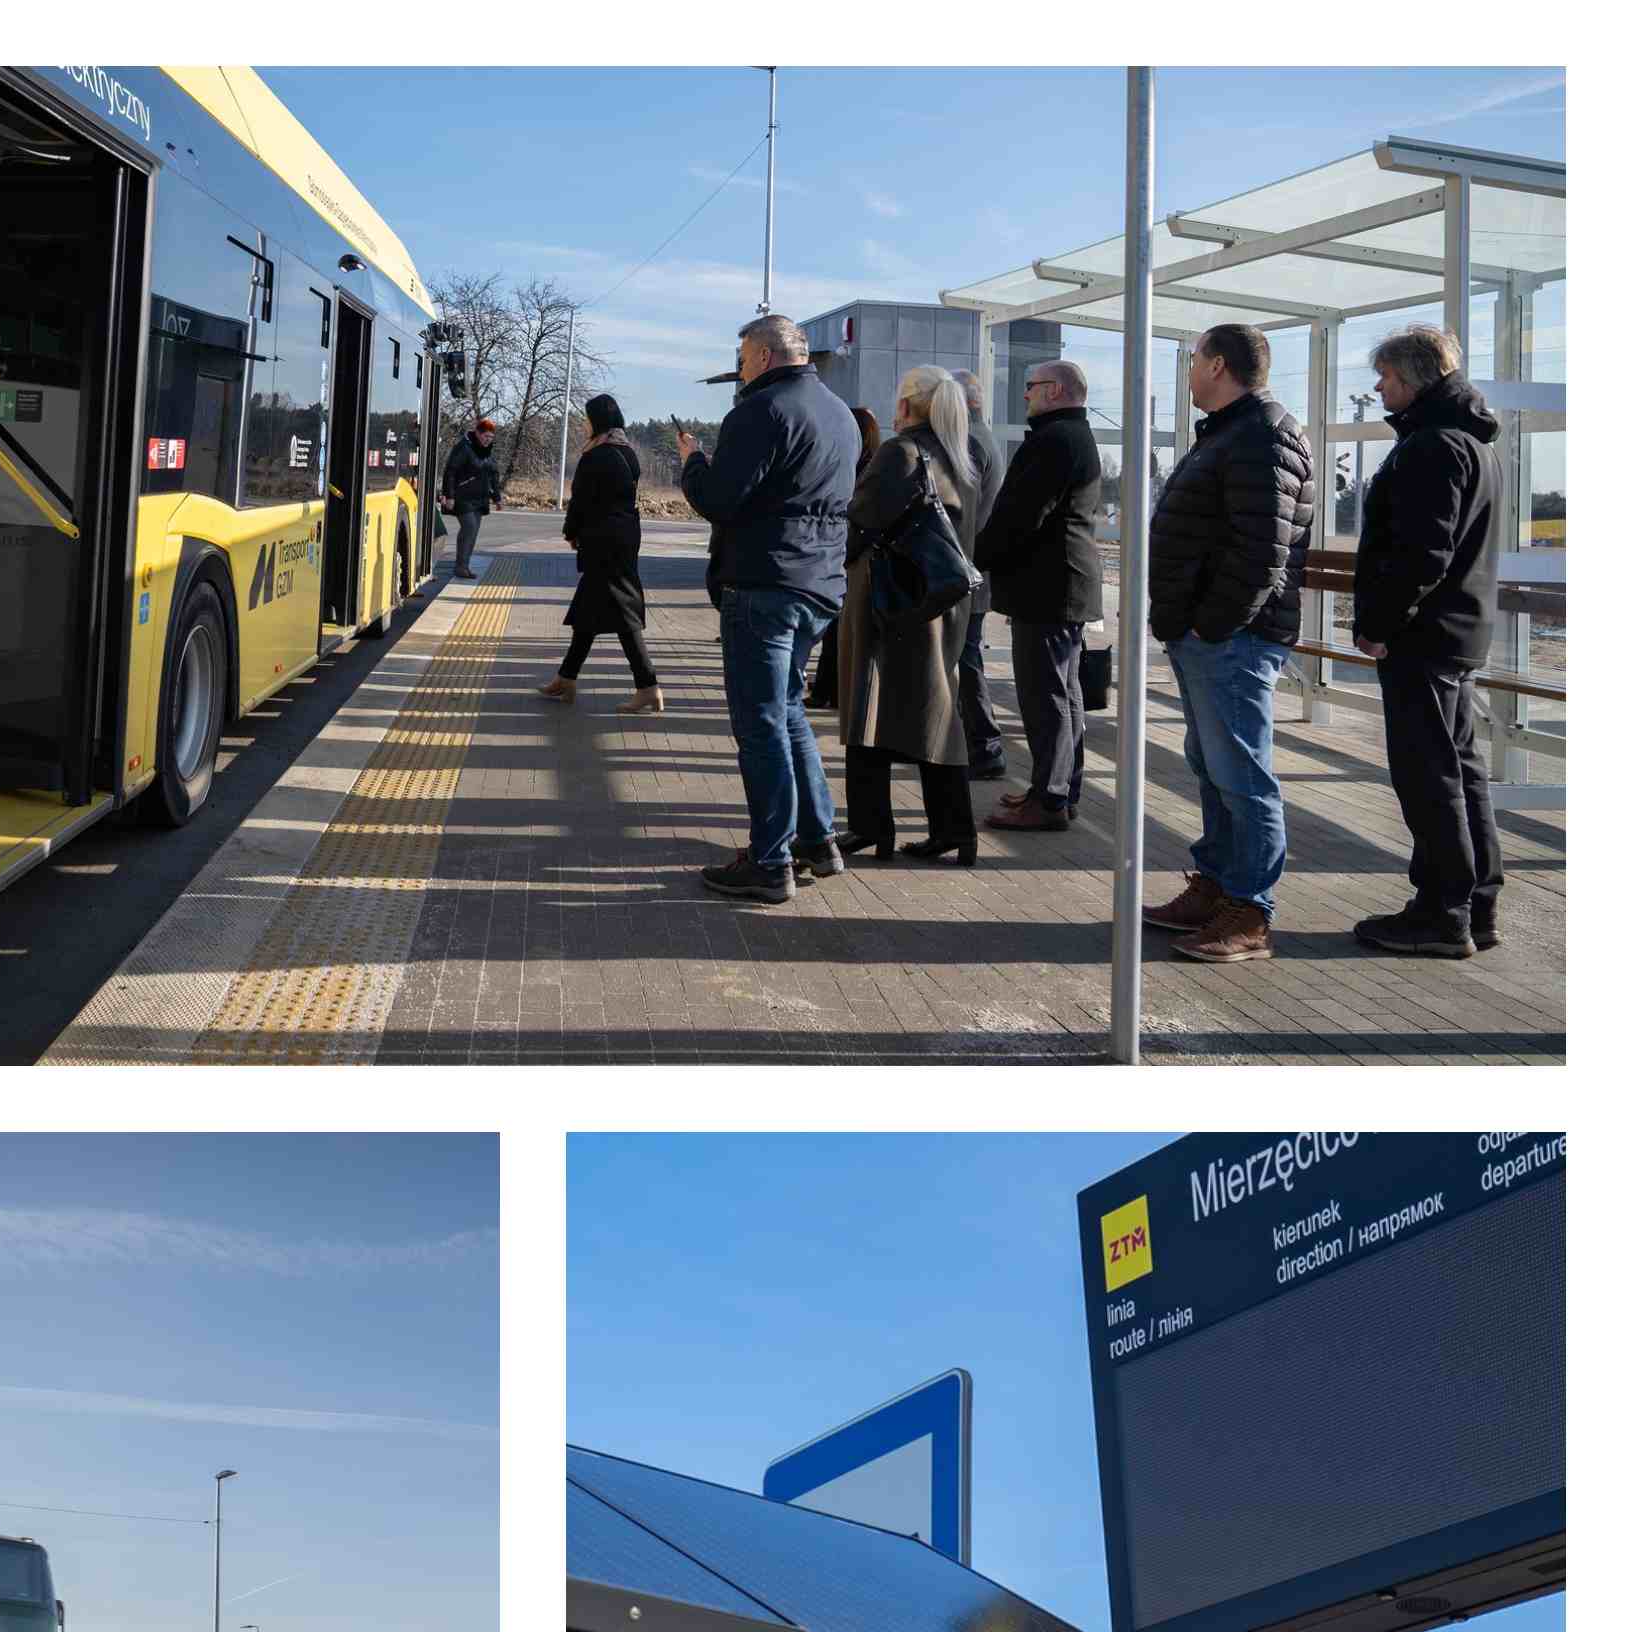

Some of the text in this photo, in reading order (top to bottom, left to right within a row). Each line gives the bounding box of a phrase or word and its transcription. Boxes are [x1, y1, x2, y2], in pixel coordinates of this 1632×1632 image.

[1480, 1135, 1566, 1192] departure
[1272, 1199, 1342, 1252] kierunek
[1275, 1191, 1446, 1285] direction / напрямок
[1106, 1299, 1137, 1328] linia
[1109, 1305, 1194, 1360] route / лінія
